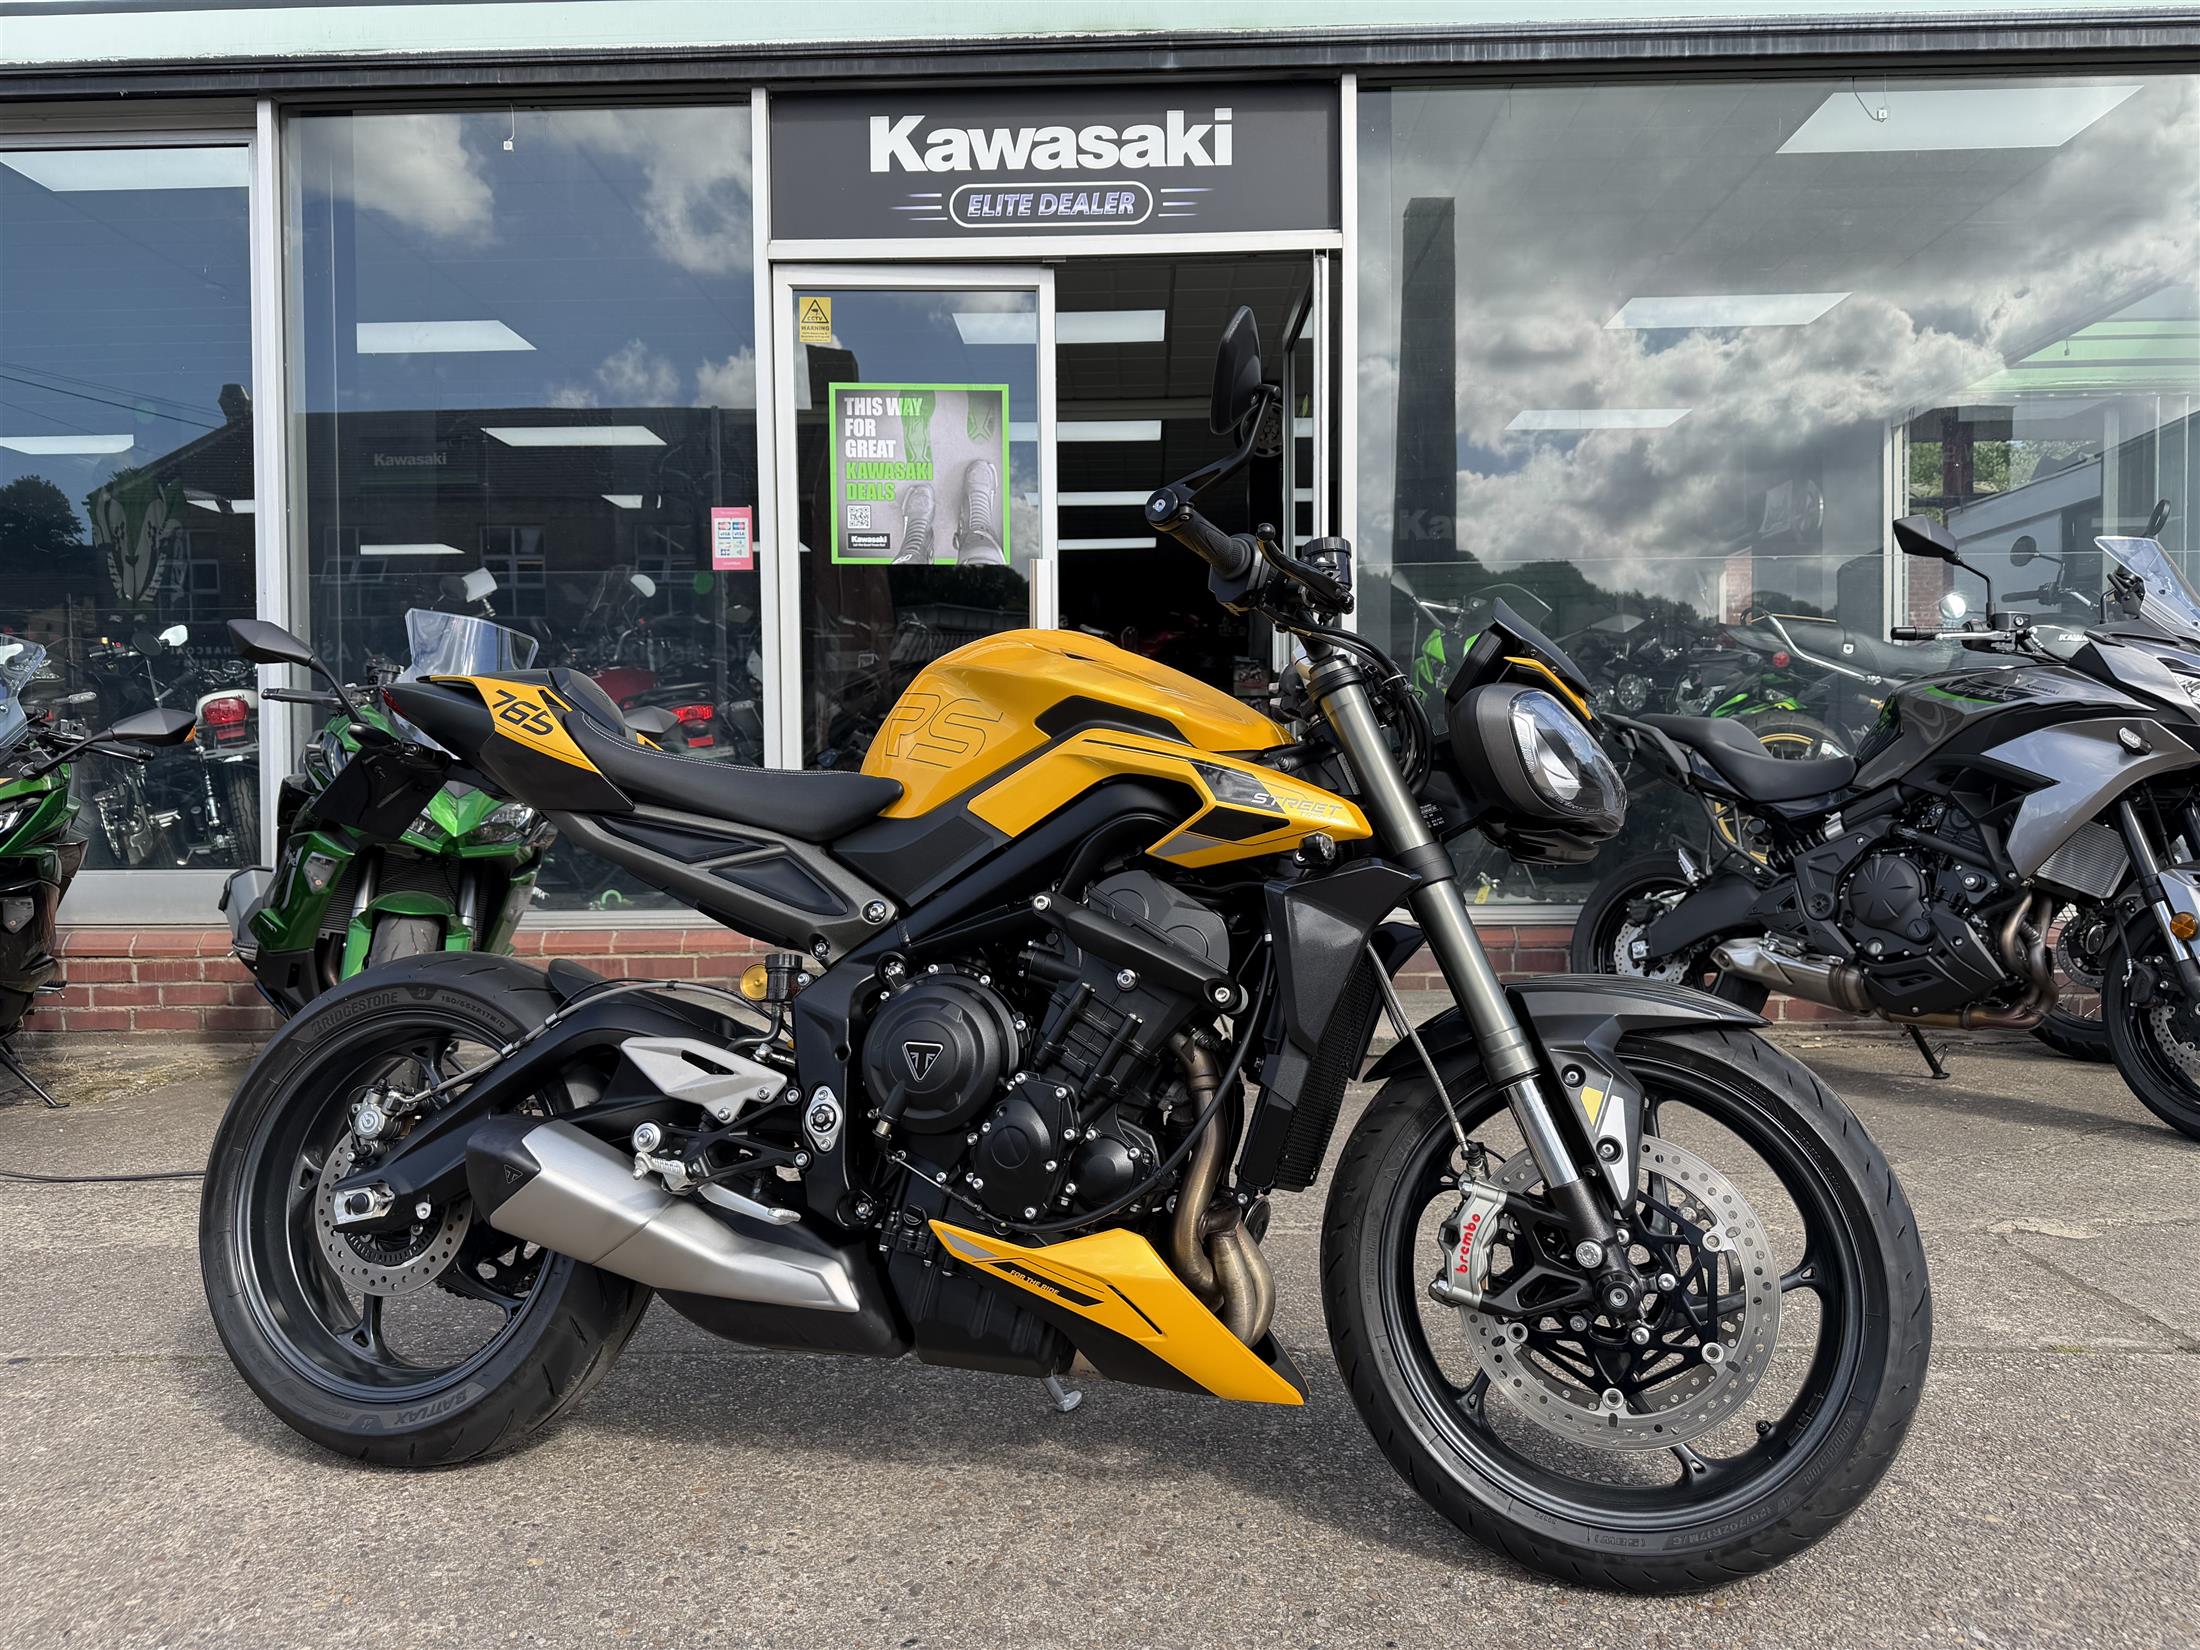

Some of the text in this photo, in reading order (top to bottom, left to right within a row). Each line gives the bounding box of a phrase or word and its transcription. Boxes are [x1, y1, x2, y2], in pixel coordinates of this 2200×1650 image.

[869, 107, 1233, 173] Kawasaki
[966, 191, 1137, 218] ELITE DEALER
[844, 397, 923, 416] THIS WAY
[845, 418, 877, 437] FOR
[373, 452, 447, 466] Kawasaki
[845, 439, 897, 458] GREAT
[845, 461, 934, 480] KAWASAKI
[846, 482, 896, 500] DEALS
[851, 535, 887, 543] Kawasaki
[492, 689, 554, 735] 765
[885, 692, 1004, 768] RS
[1251, 793, 1344, 816] STREET
[310, 991, 399, 1034] BRIDGESTONE
[1455, 1213, 1481, 1274] brembo
[1010, 1269, 1060, 1295] FOR THE RIDE
